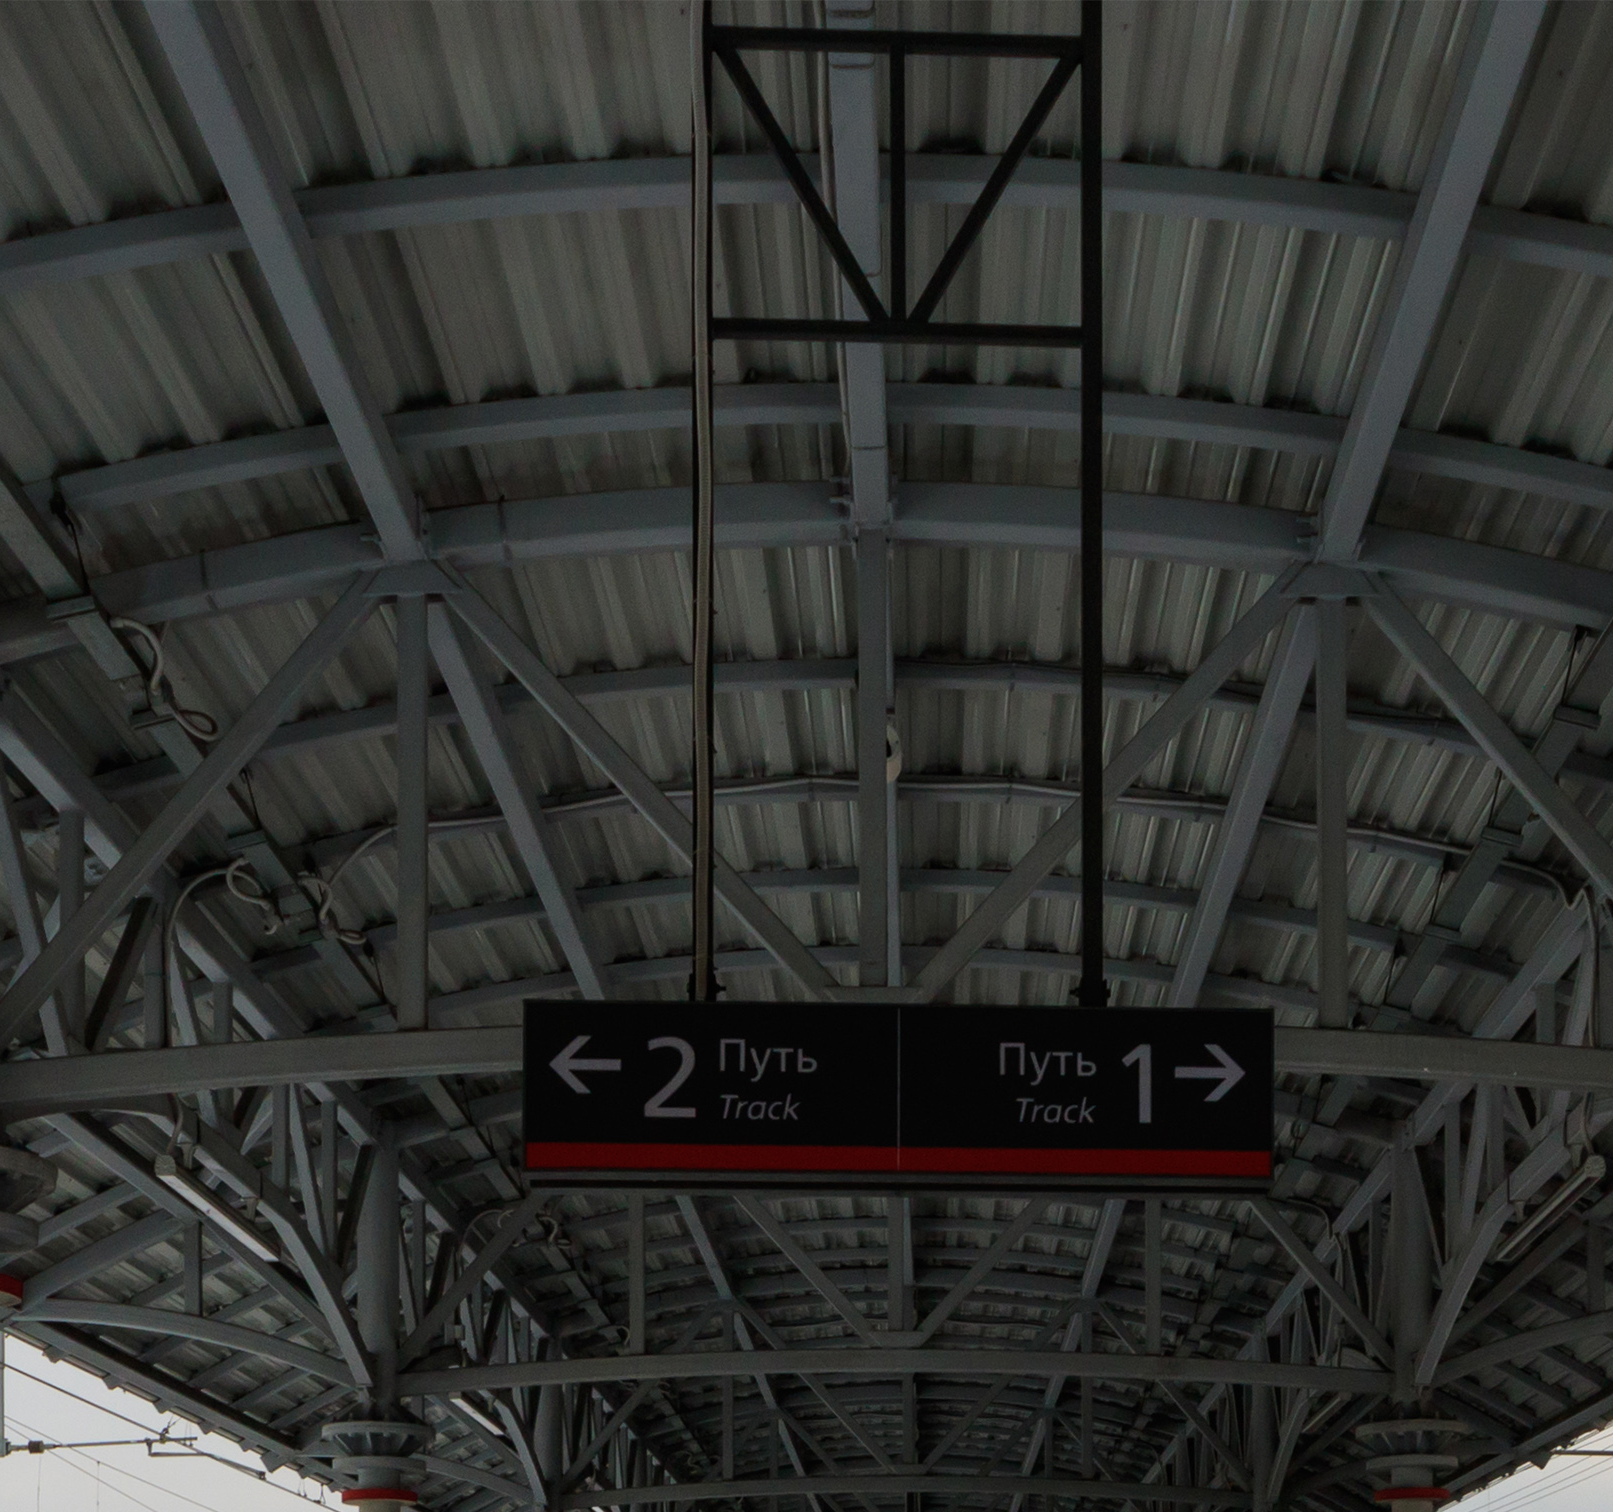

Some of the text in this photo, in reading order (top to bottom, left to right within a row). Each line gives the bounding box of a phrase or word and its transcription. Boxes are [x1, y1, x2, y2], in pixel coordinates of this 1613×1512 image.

[644, 1037, 697, 1118] 2
[719, 1039, 818, 1082] Путь
[999, 1043, 1097, 1086] Путь
[1122, 1044, 1152, 1123] 1
[721, 1094, 800, 1121] Track
[1016, 1097, 1096, 1125] Track
